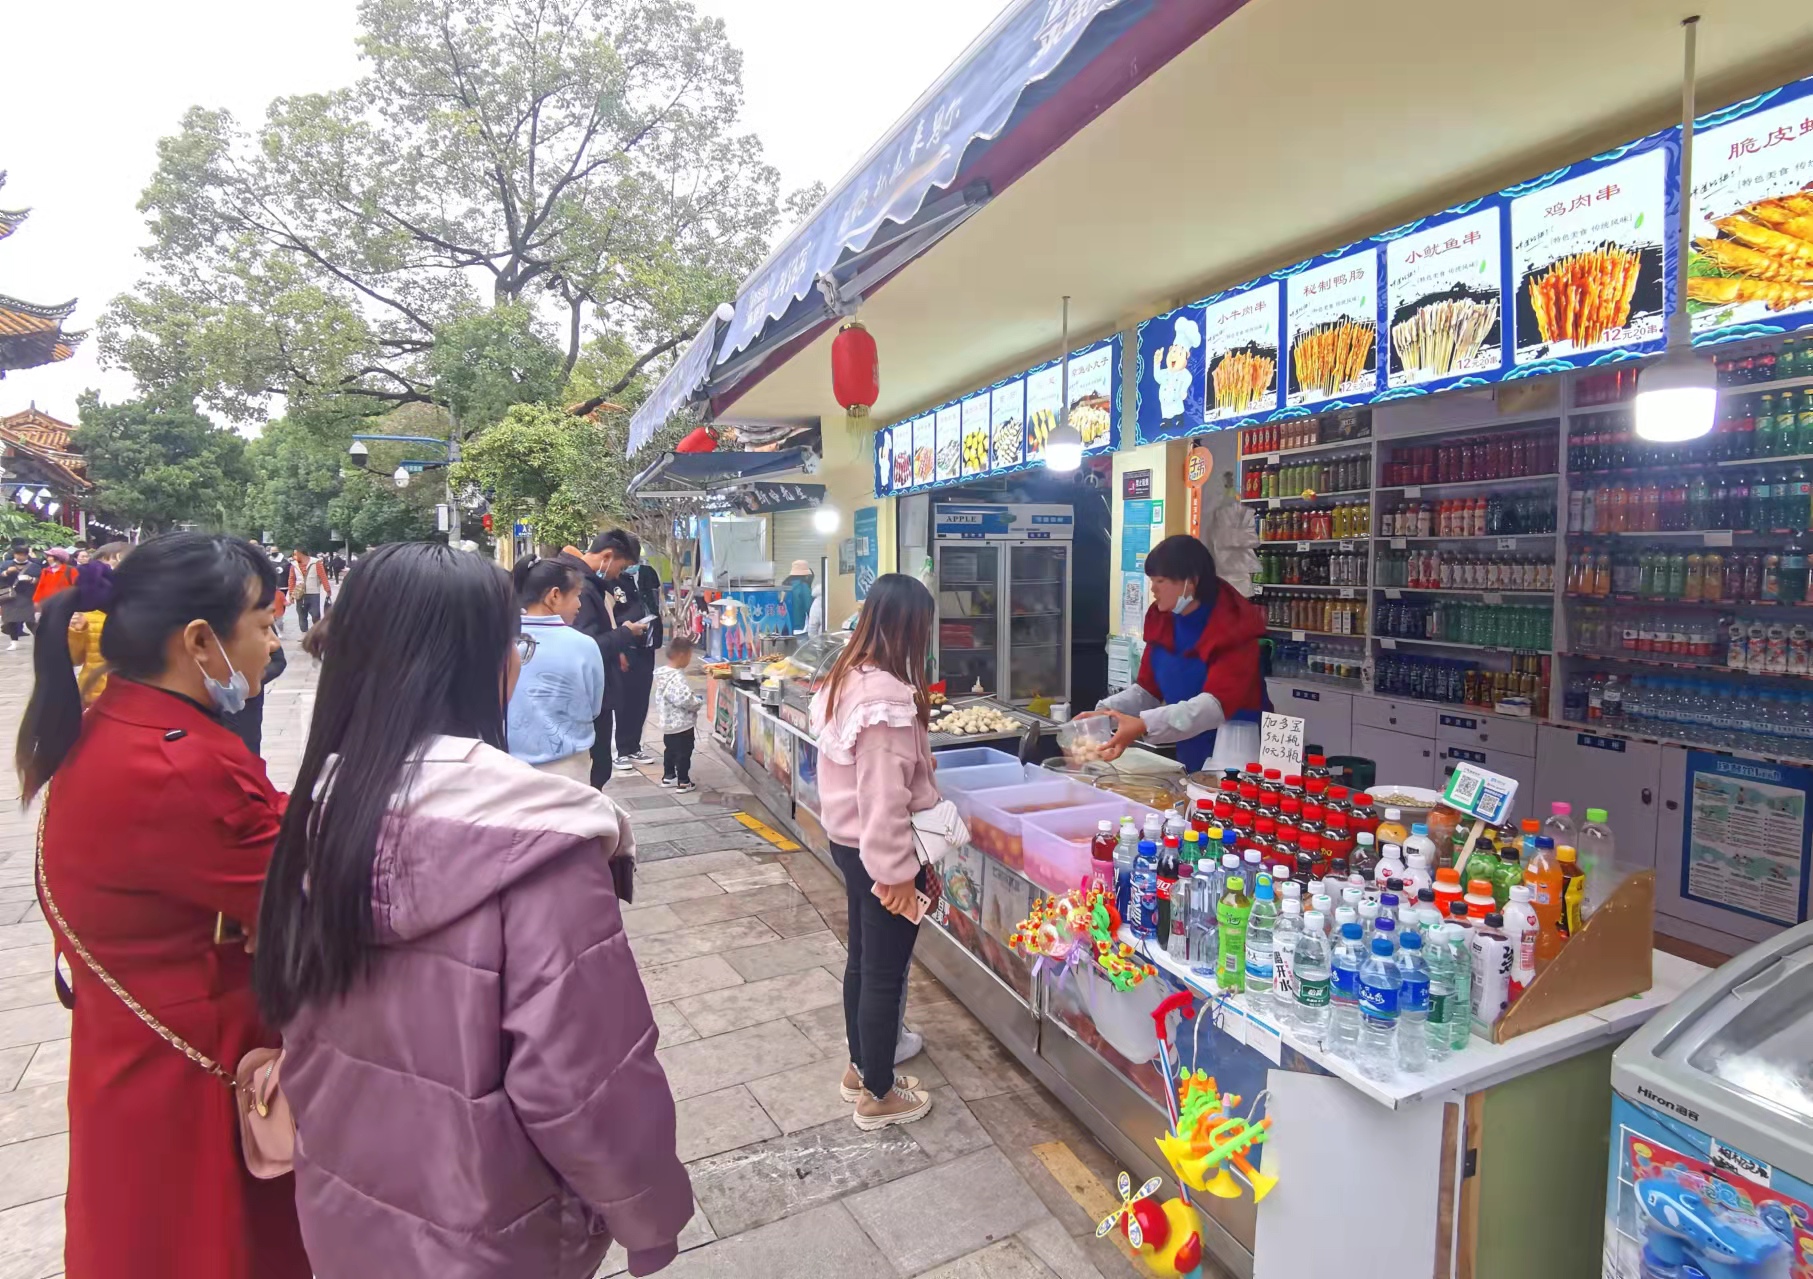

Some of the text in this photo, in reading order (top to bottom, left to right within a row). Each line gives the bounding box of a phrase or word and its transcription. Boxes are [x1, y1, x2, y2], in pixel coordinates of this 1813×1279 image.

[1543, 184, 1621, 218] 鸡肉串
[1404, 230, 1482, 264] 小鱿鱼串
[1303, 268, 1365, 297] 秘制鸭肠
[1217, 300, 1267, 325] 小牛肉串
[1601, 324, 1659, 345] 12元20串
[1456, 357, 1498, 371] 12元20串
[946, 515, 977, 523] APPLE
[1262, 714, 1303, 733] 加多宝
[1263, 731, 1300, 747] 5元1瓶
[1261, 745, 1303, 764] 10元3瓶
[1637, 1085, 1675, 1110] Hiron
